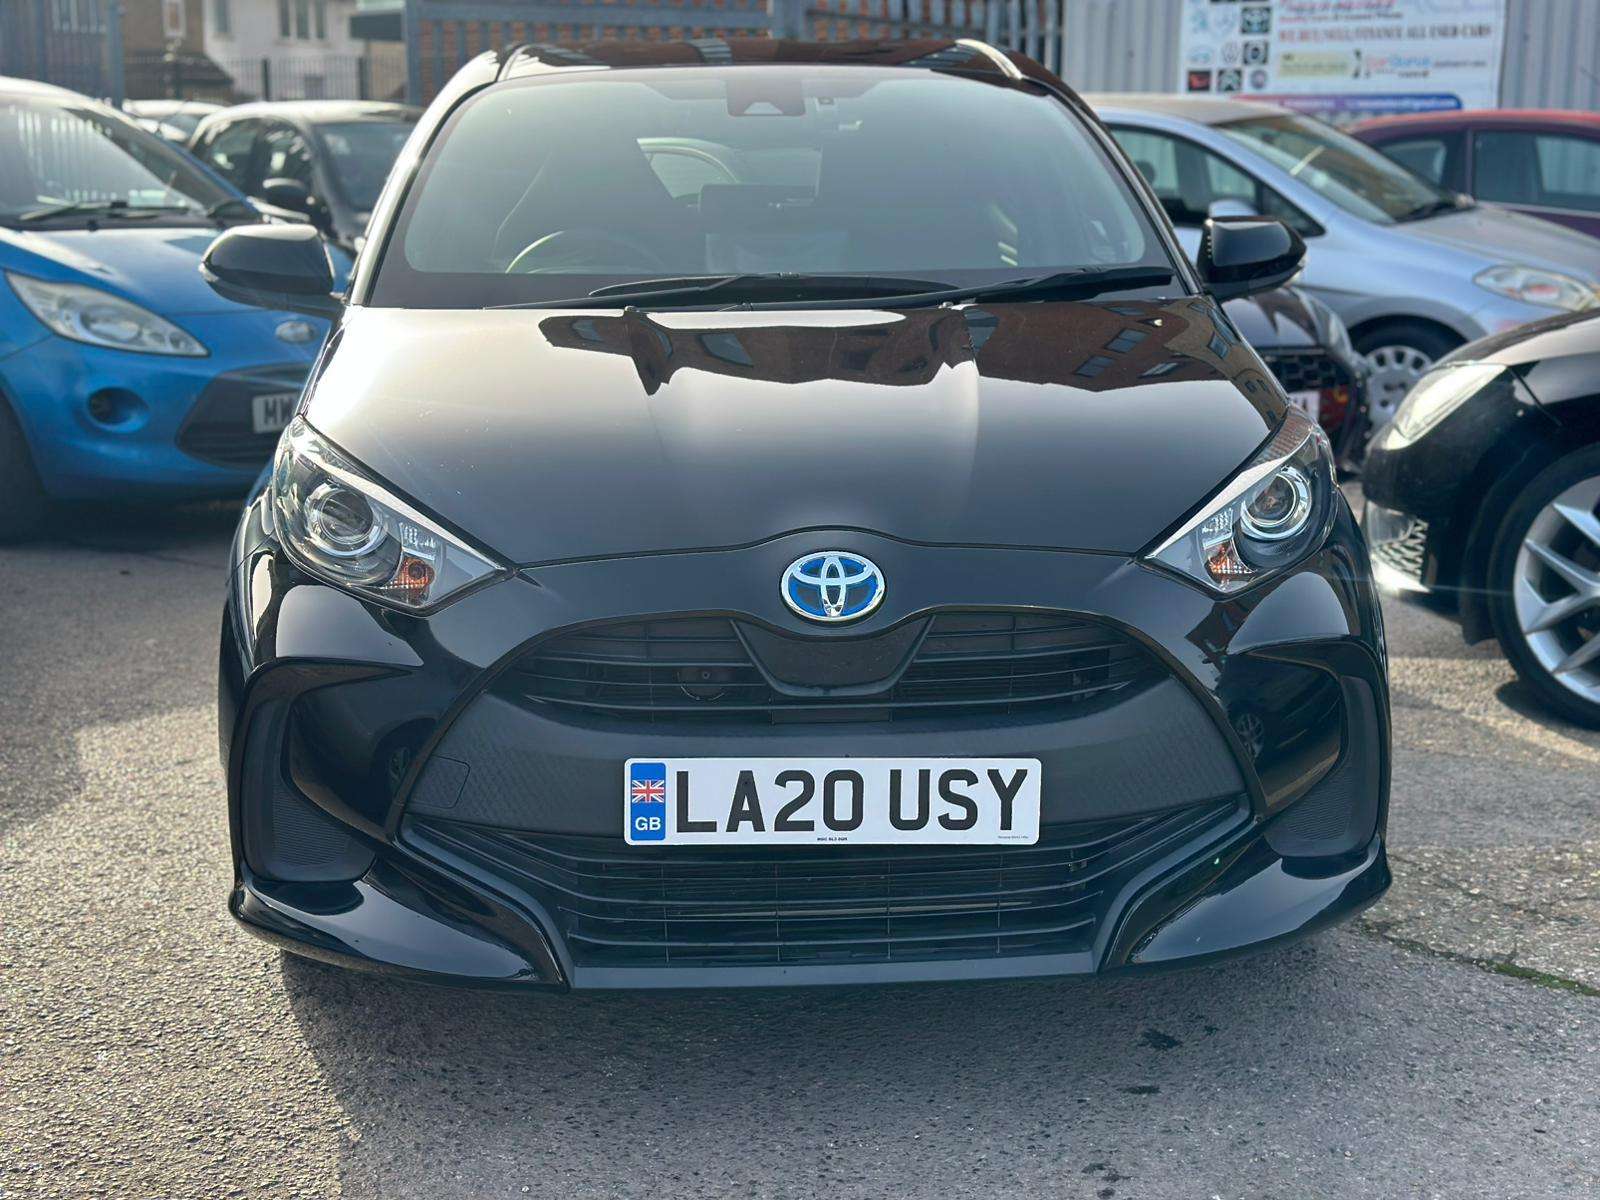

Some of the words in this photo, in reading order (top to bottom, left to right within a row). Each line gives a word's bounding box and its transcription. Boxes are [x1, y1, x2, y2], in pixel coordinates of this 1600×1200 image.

[676, 769, 864, 833] LA20
[889, 769, 1028, 831] USY
[635, 816, 661, 831] GB
